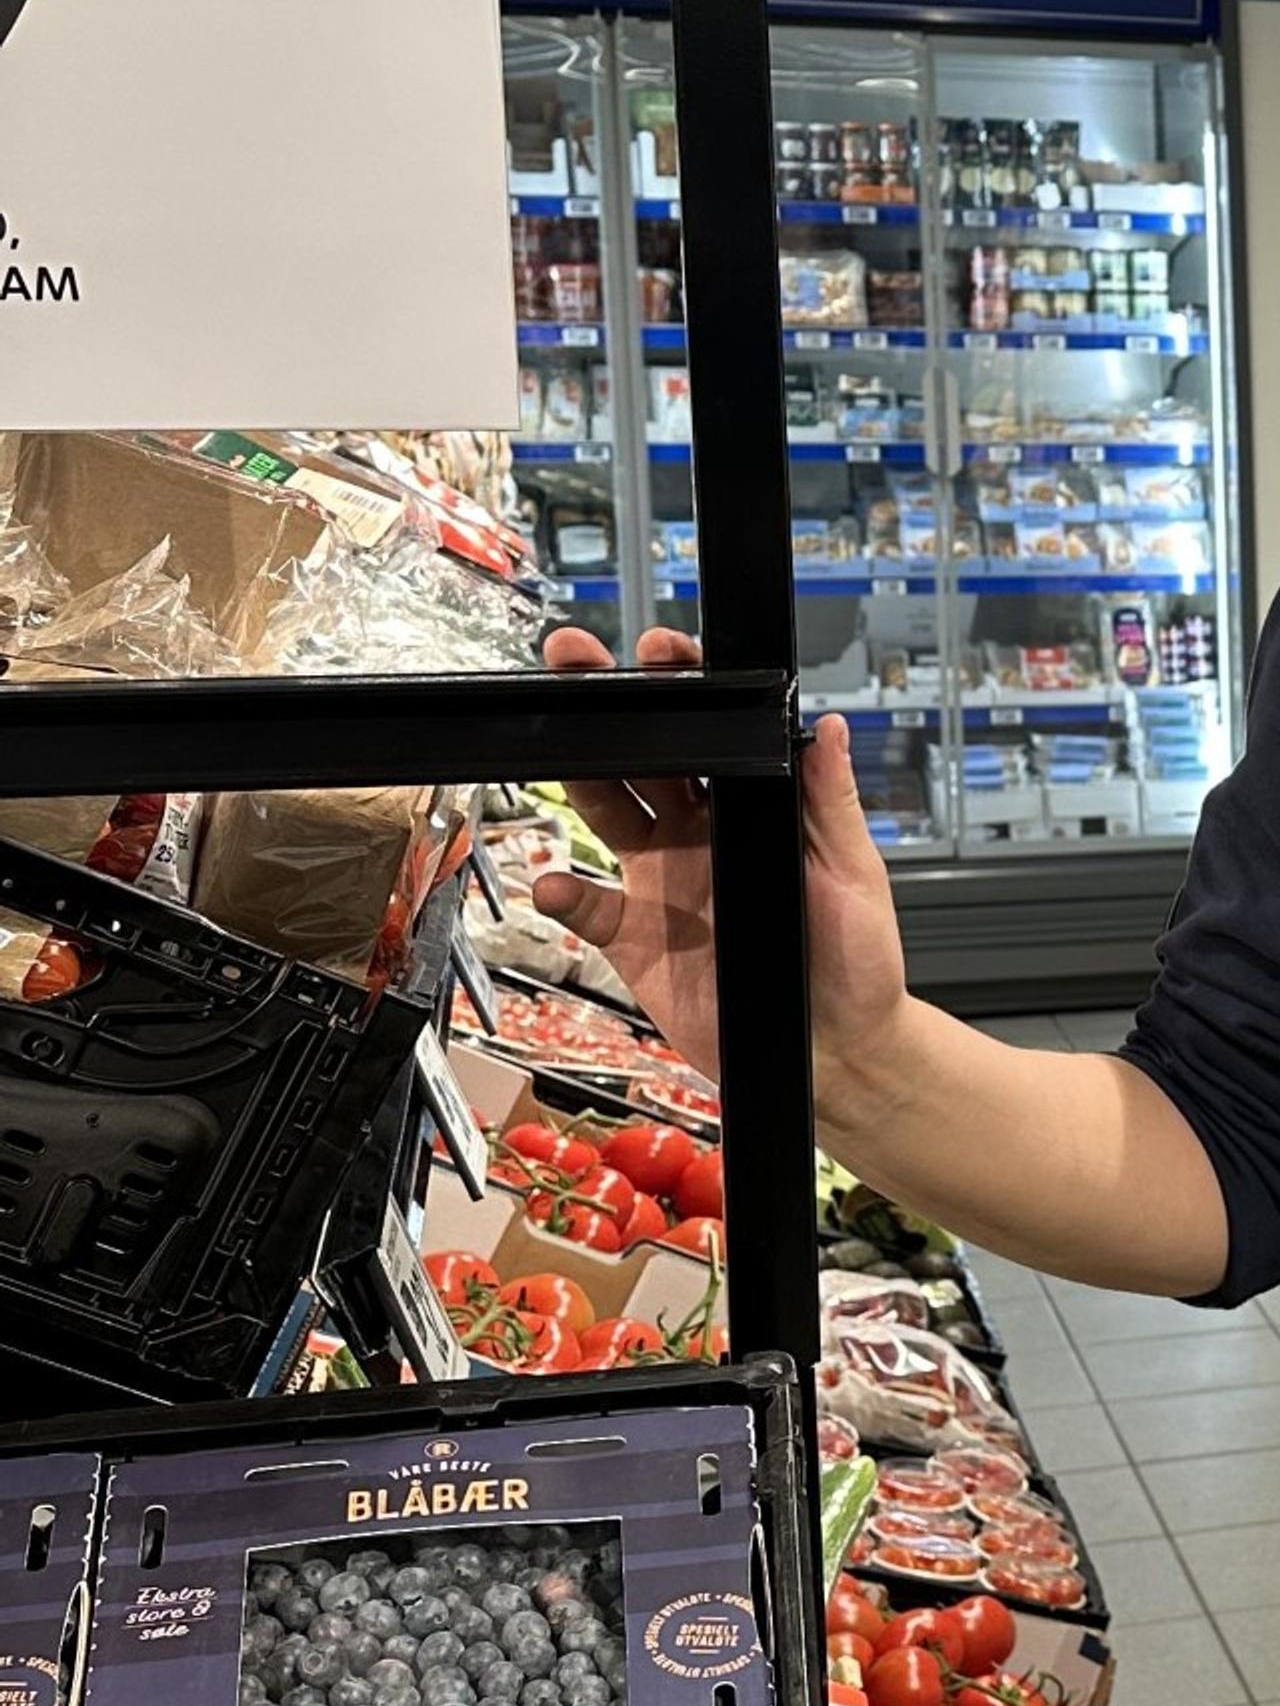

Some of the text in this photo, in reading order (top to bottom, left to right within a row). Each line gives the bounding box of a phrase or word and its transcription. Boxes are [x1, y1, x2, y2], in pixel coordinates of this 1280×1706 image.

[347, 1478, 529, 1523] BLÅBÆR
[136, 1586, 216, 1605] Ekstra
[126, 1607, 186, 1625] store
